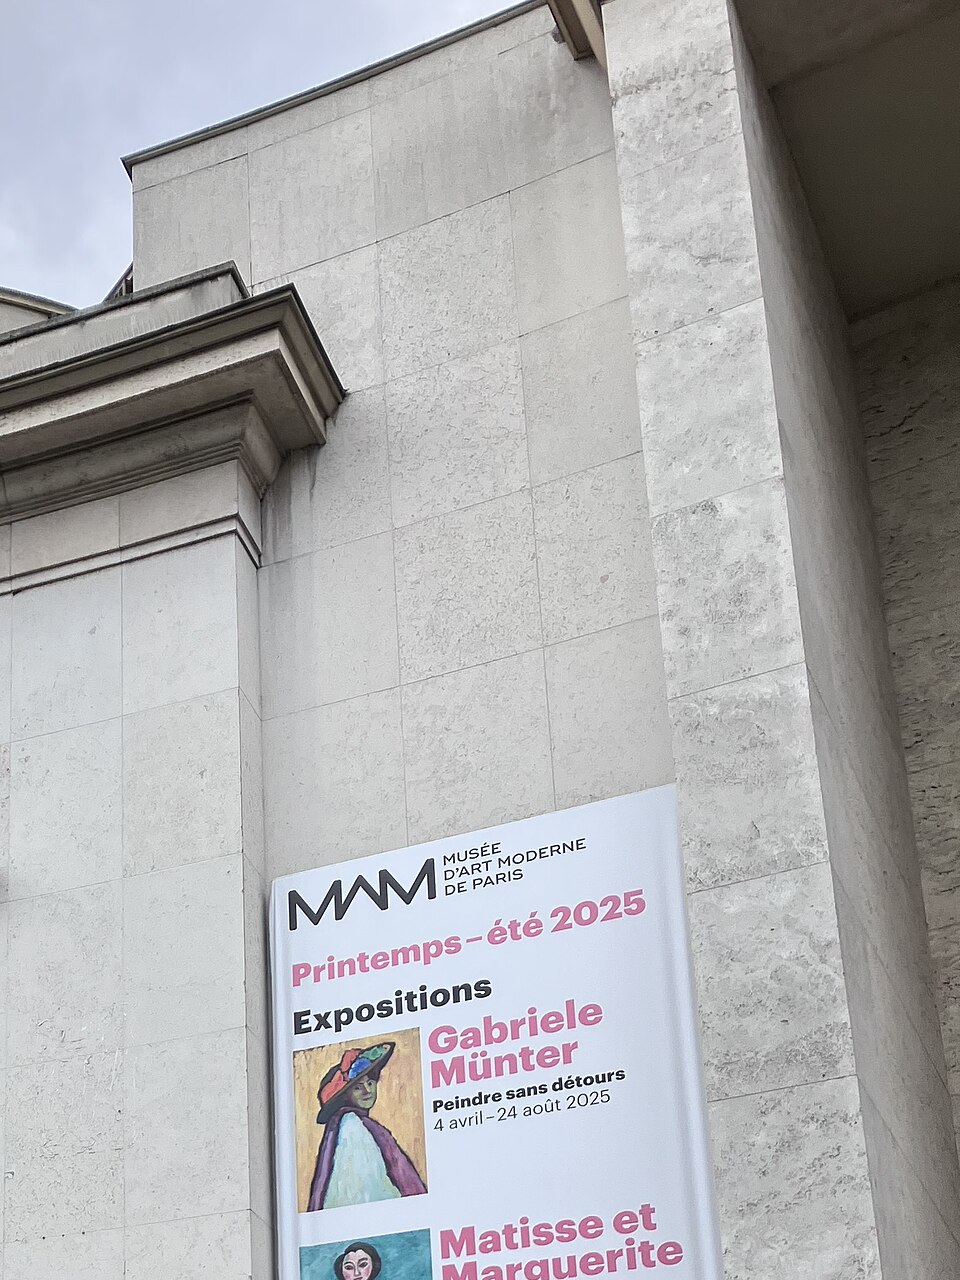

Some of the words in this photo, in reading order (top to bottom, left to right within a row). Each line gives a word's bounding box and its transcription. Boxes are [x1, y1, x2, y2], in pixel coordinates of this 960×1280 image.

[442, 842, 502, 865] MUSÉE
[497, 838, 587, 869] MODERNE
[288, 857, 437, 931] MAM
[444, 882, 468, 896] DE
[473, 868, 524, 889] PARIS
[550, 888, 646, 934] 2025
[292, 977, 493, 1035] Expositions
[427, 999, 604, 1055] Gabriele
[430, 1038, 579, 1089] Münter
[432, 1091, 502, 1113] Peindre
[505, 1082, 548, 1100] sans
[552, 1068, 626, 1092] détours
[433, 1118, 444, 1132] 4
[522, 1098, 562, 1118] août
[566, 1090, 611, 1110] 2025
[440, 1216, 604, 1259] Matisse
[613, 1203, 657, 1234] et
